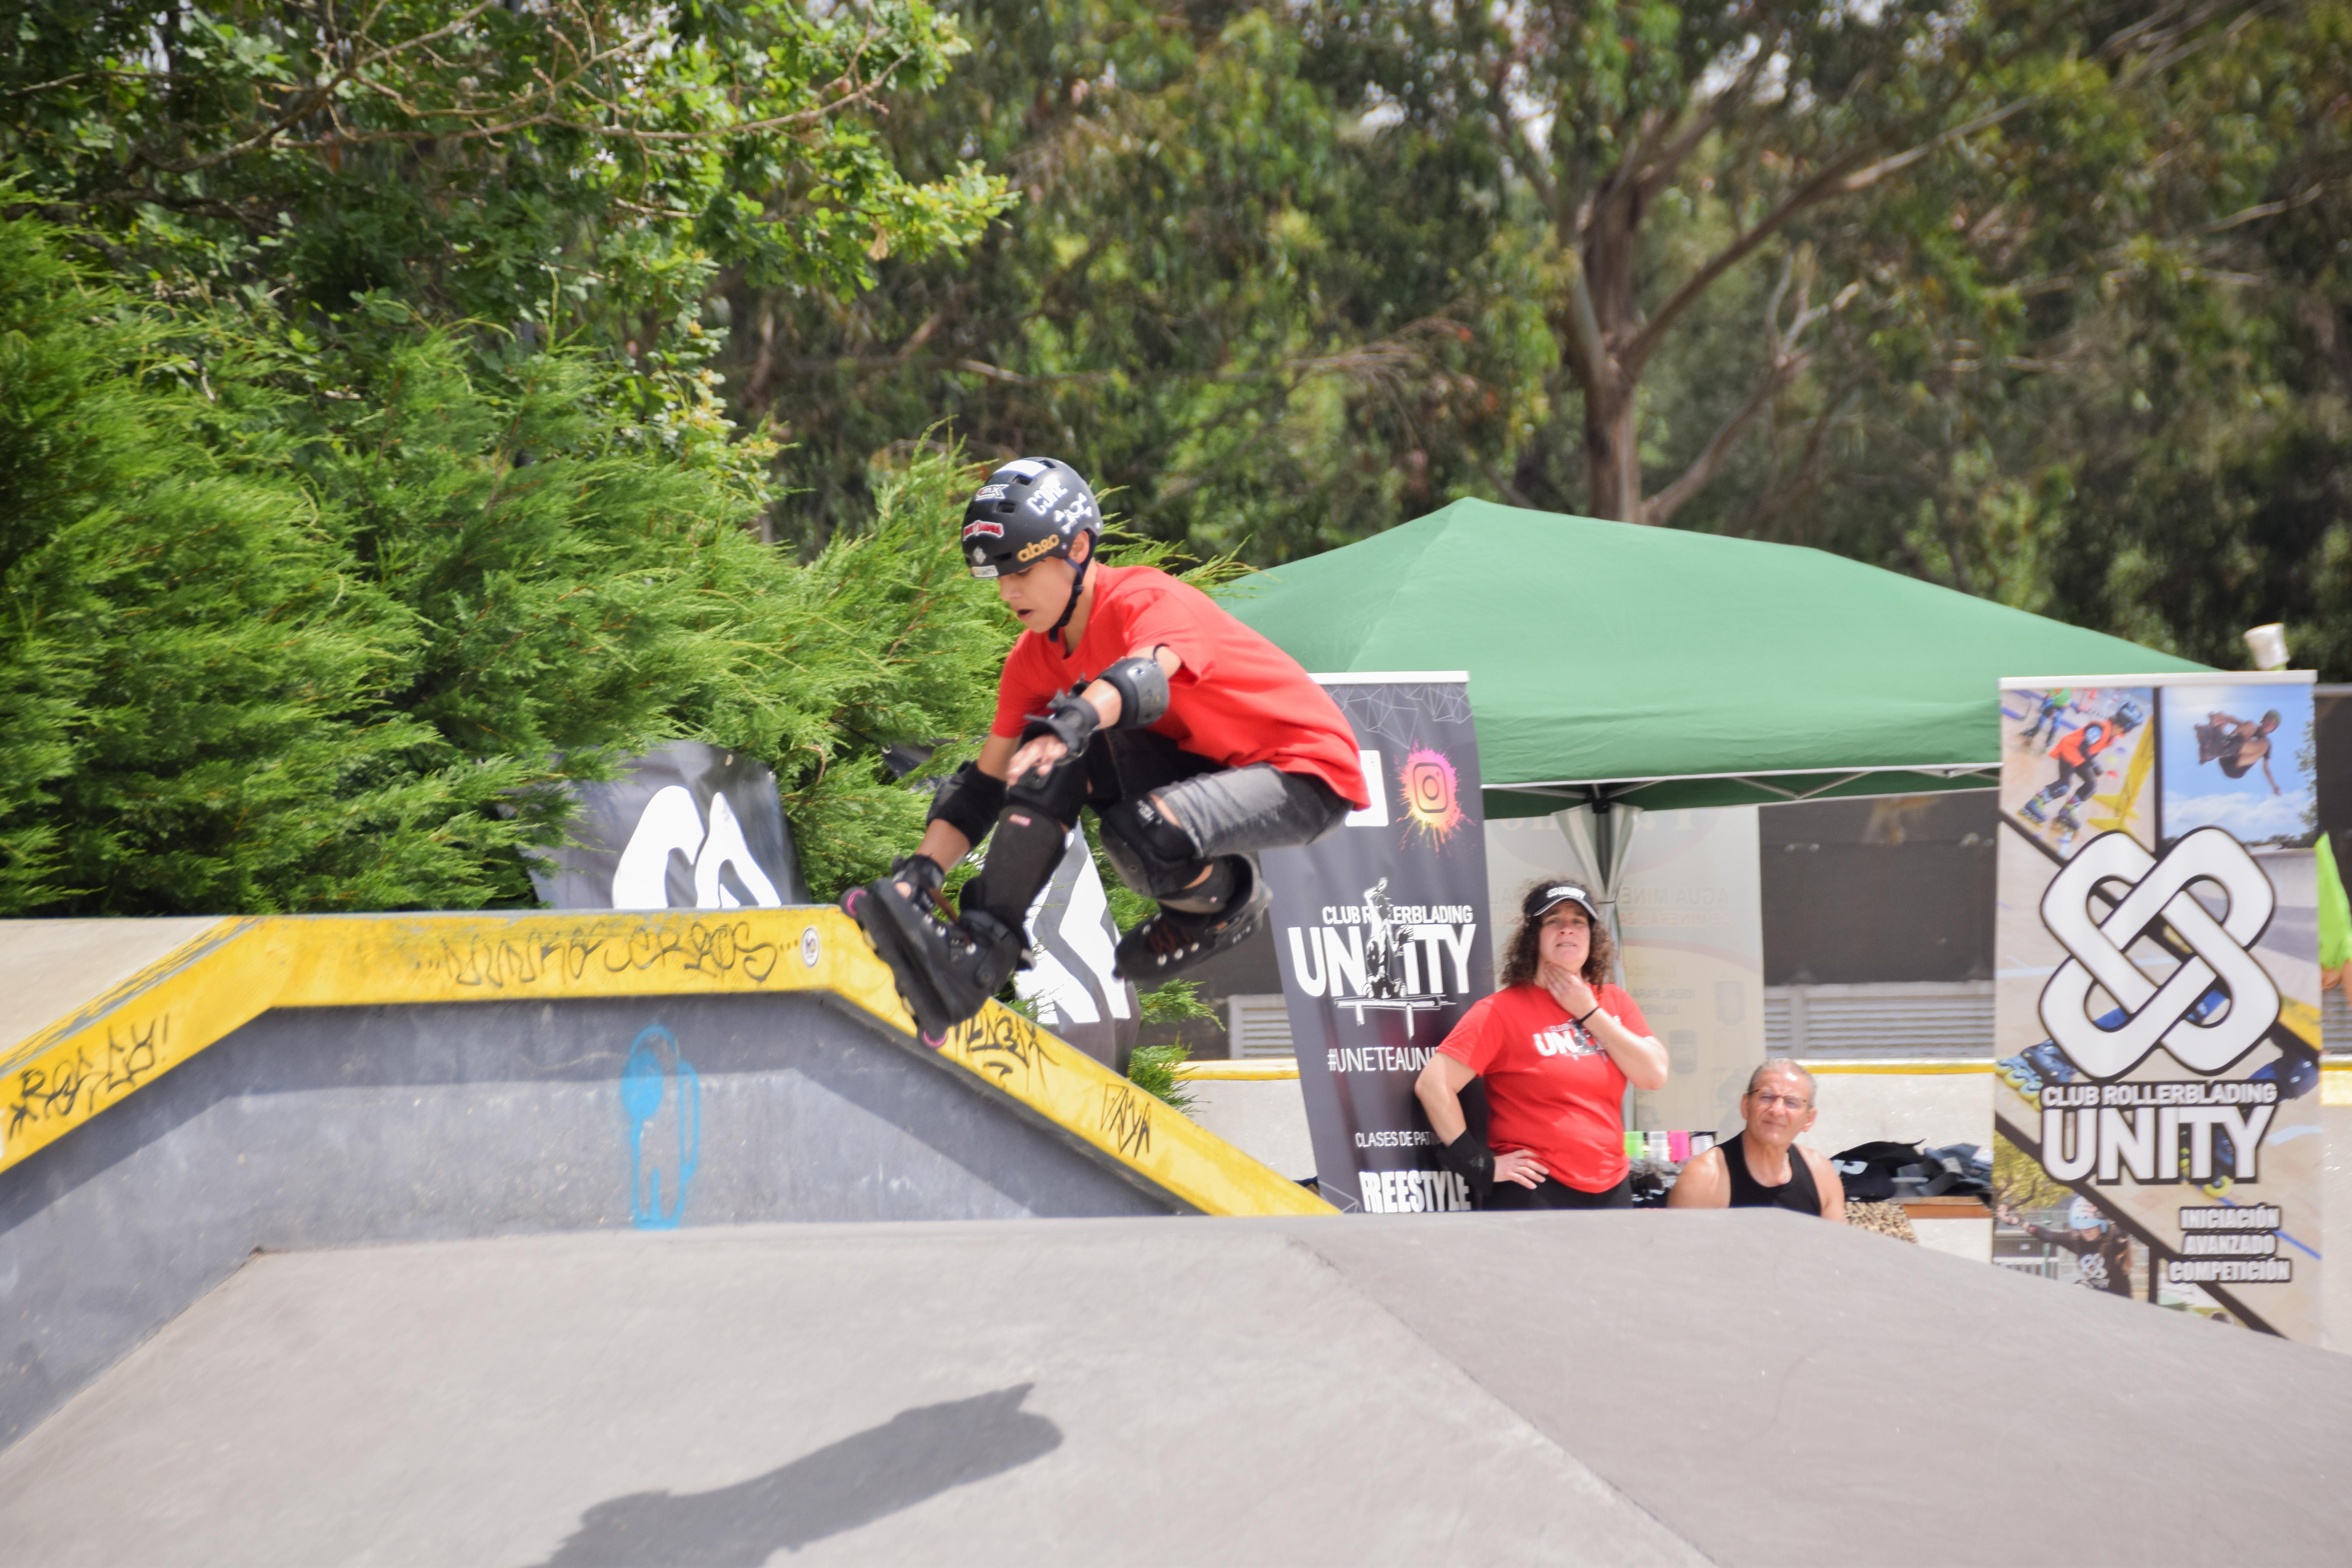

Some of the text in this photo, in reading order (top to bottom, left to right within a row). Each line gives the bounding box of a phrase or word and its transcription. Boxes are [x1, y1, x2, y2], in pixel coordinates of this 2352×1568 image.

[1017, 534, 1060, 562] abec
[1322, 906, 1361, 924] CLUB
[1362, 905, 1474, 924] RLERBLADING
[1288, 924, 1477, 997] UNITY
[2042, 1082, 2278, 1106] CLUB ROLLERBLADING
[1355, 1131, 1398, 1147] CLASES
[1399, 1131, 1414, 1146] DE
[2042, 1105, 2276, 1181] UNITY
[2180, 1203, 2280, 1230] INICIACIÓN
[2183, 1233, 2276, 1256] AVANZADO
[2169, 1258, 2292, 1282] COMPETICIÓN
